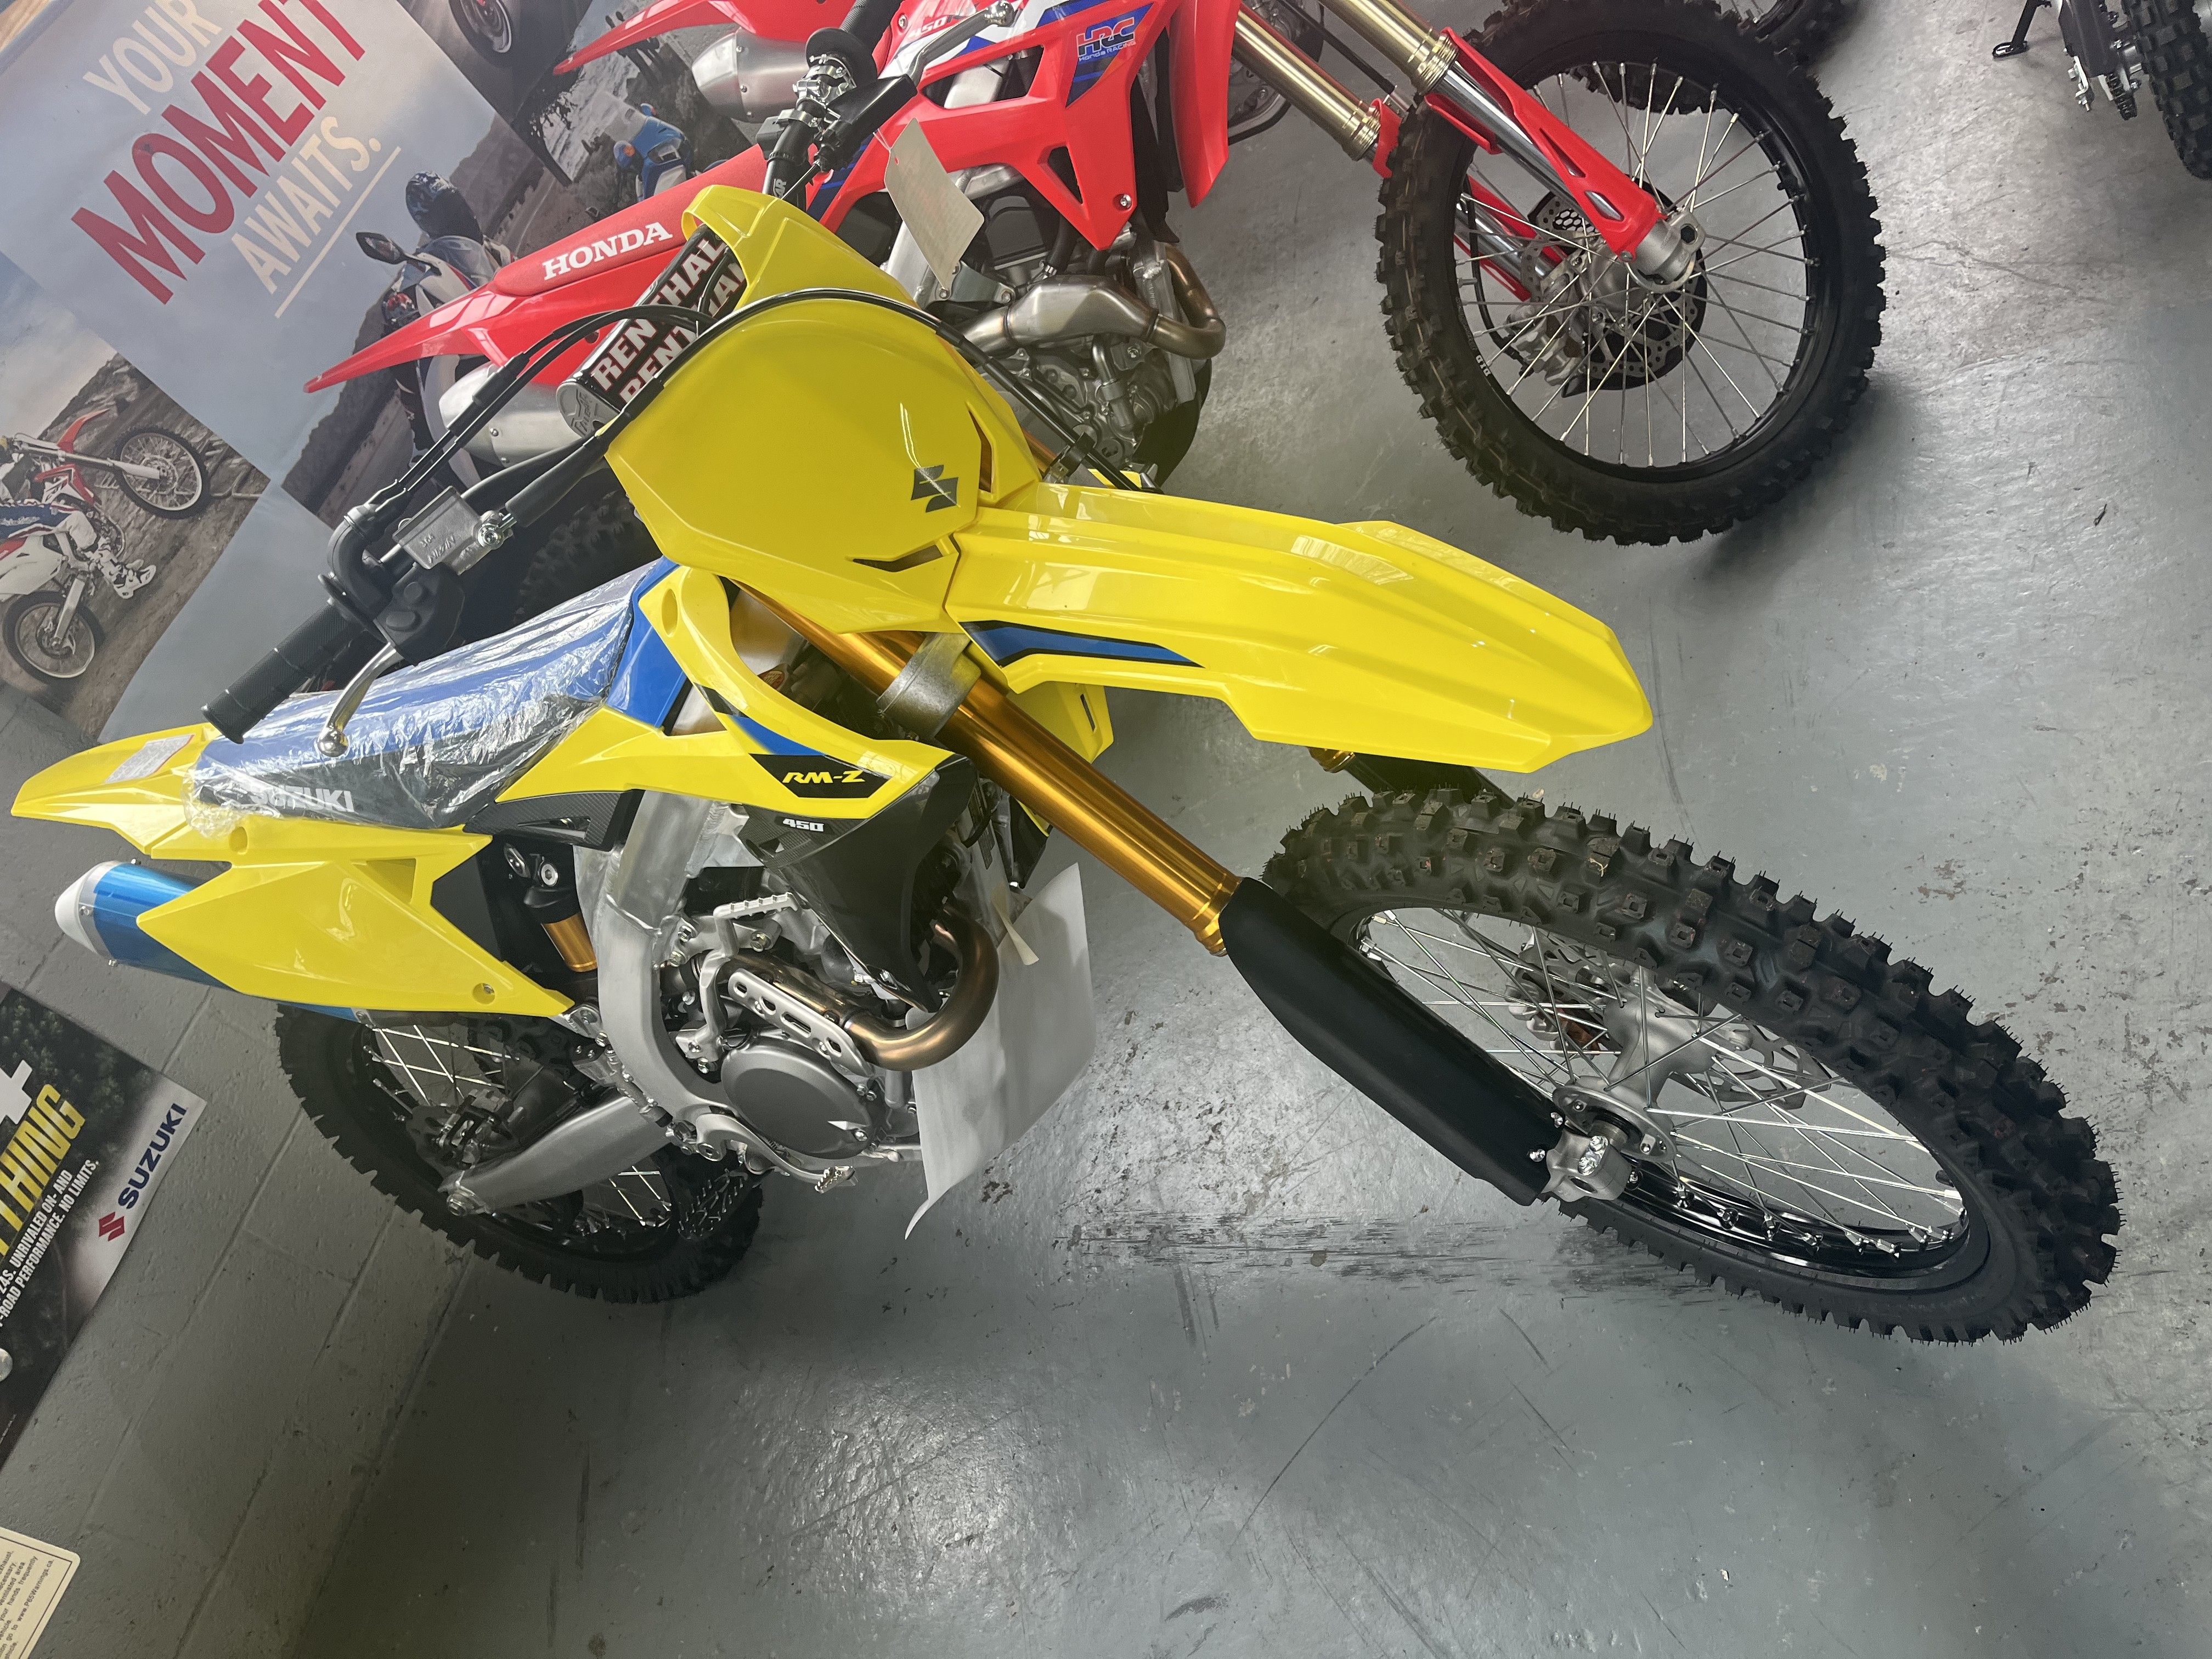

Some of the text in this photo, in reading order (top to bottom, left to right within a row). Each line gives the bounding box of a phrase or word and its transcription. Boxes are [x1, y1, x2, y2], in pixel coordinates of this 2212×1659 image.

[83, 0, 223, 116] YOUR
[1076, 16, 1135, 57] HRC
[1106, 40, 1137, 54] RACING
[231, 116, 382, 295] AWAITS.
[542, 221, 674, 280] HONDA
[250, 785, 354, 812] SUZUKI
[782, 770, 866, 783] RM-Z
[783, 818, 824, 832] 450
[117, 1103, 189, 1210] SUZUKI
[9, 1210, 48, 1268] UNRIVALED
[41, 1193, 57, 1214] ON-
[53, 1169, 73, 1195] AND
[14, 1212, 66, 1289] PERFORMANCE.
[58, 1193, 75, 1212] NO
[67, 1159, 100, 1195] LIMITS.
[7, 1587, 21, 1606] hands
[18, 1555, 38, 1585] frequently
[15, 1561, 26, 1576] area
[6, 1633, 14, 1641] go
